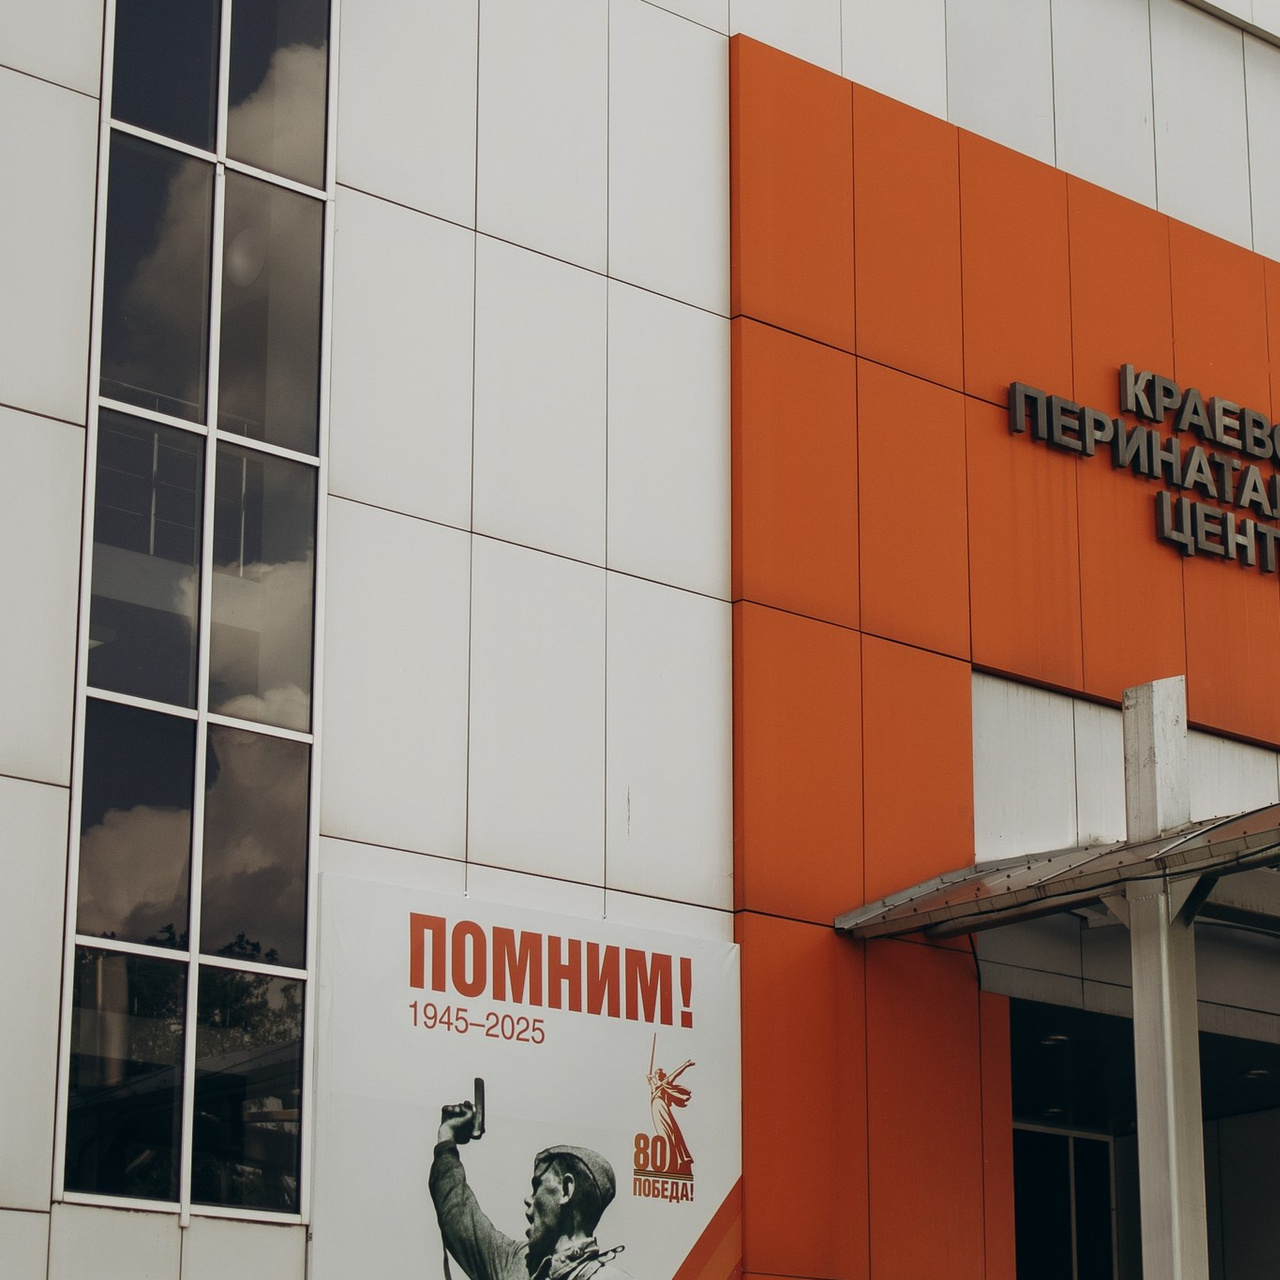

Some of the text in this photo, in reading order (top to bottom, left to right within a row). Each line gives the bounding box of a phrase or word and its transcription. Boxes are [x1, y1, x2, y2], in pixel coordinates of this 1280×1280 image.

[409, 911, 693, 1029] ПОМНИМ!
[633, 1132, 667, 1172] 80
[632, 1176, 694, 1204] ПОБЕДА!
